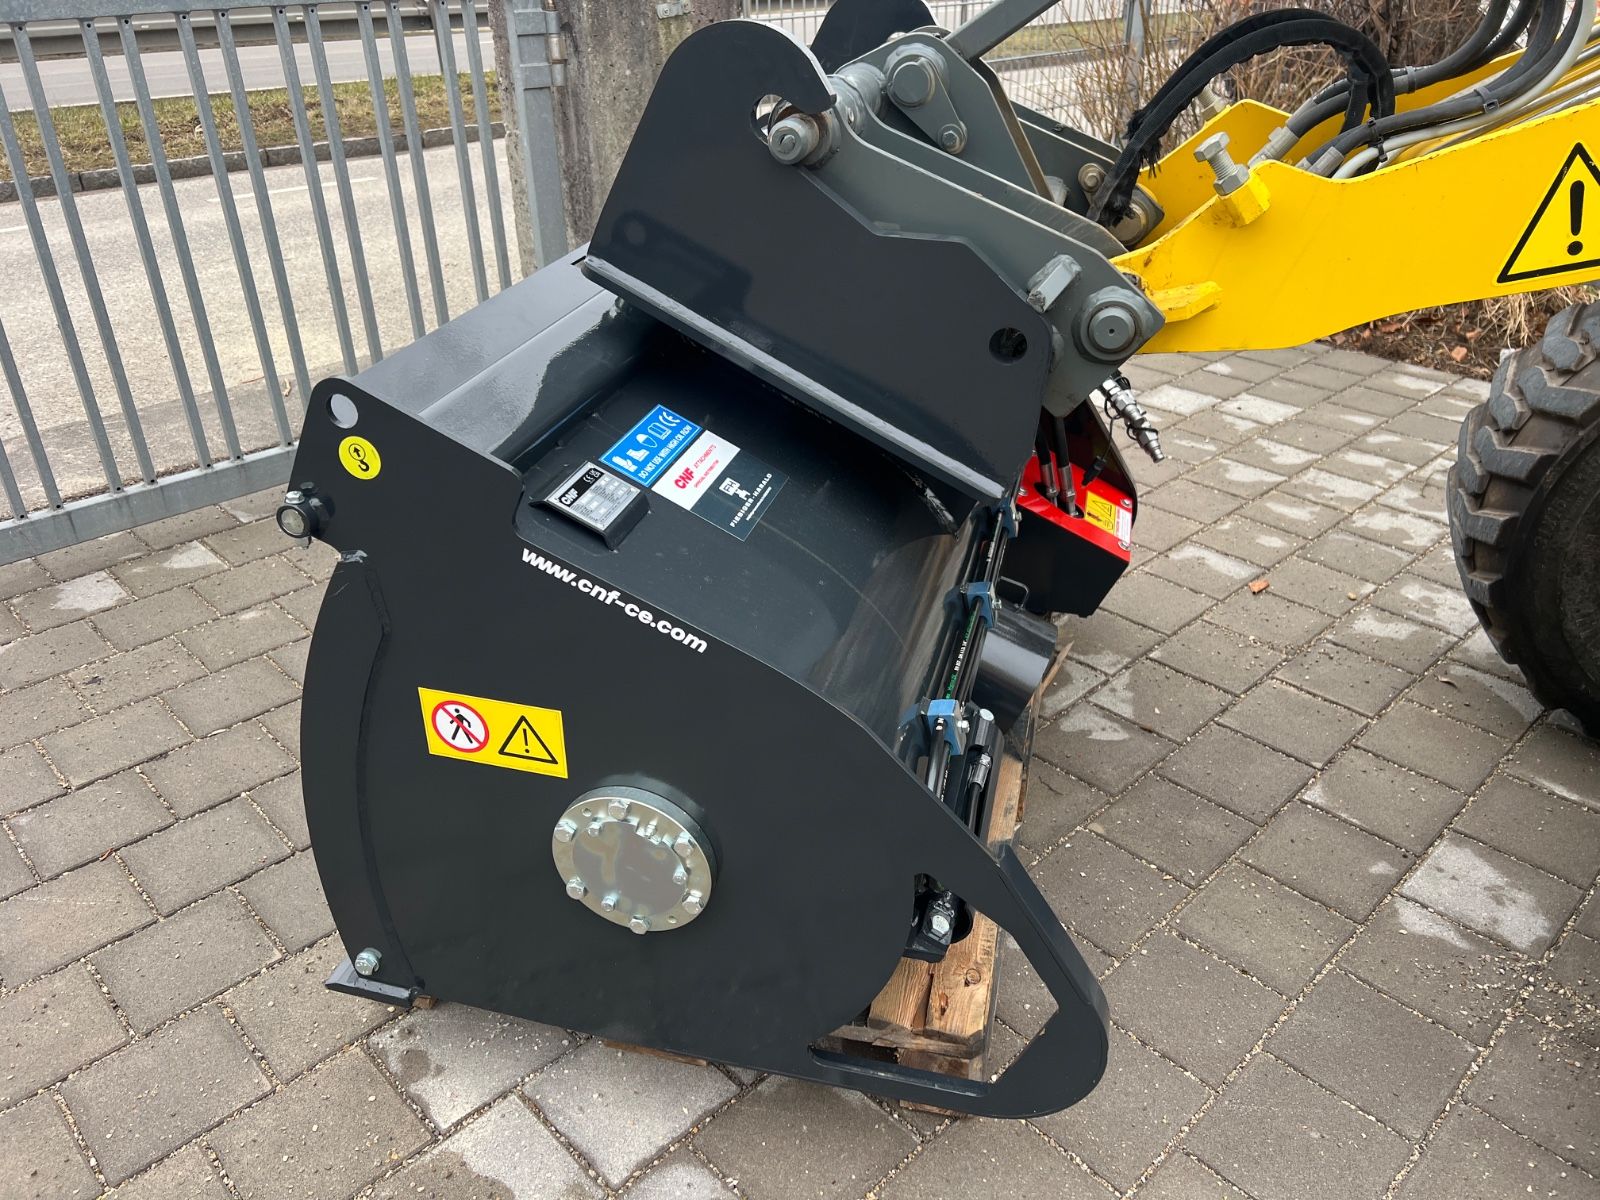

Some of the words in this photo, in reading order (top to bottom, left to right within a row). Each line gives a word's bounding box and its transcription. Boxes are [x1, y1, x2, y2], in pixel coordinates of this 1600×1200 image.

[638, 470, 649, 479] DO
[644, 462, 657, 472] NOT
[652, 456, 663, 464] USE
[658, 447, 672, 458] WITH
[666, 439, 680, 450] HIGH
[680, 424, 693, 436] FLOW
[674, 467, 694, 490] CNF
[694, 444, 717, 468] ATTACHMENTS
[560, 488, 578, 504] CNF
[521, 548, 708, 654] www.cnf-ce.com
